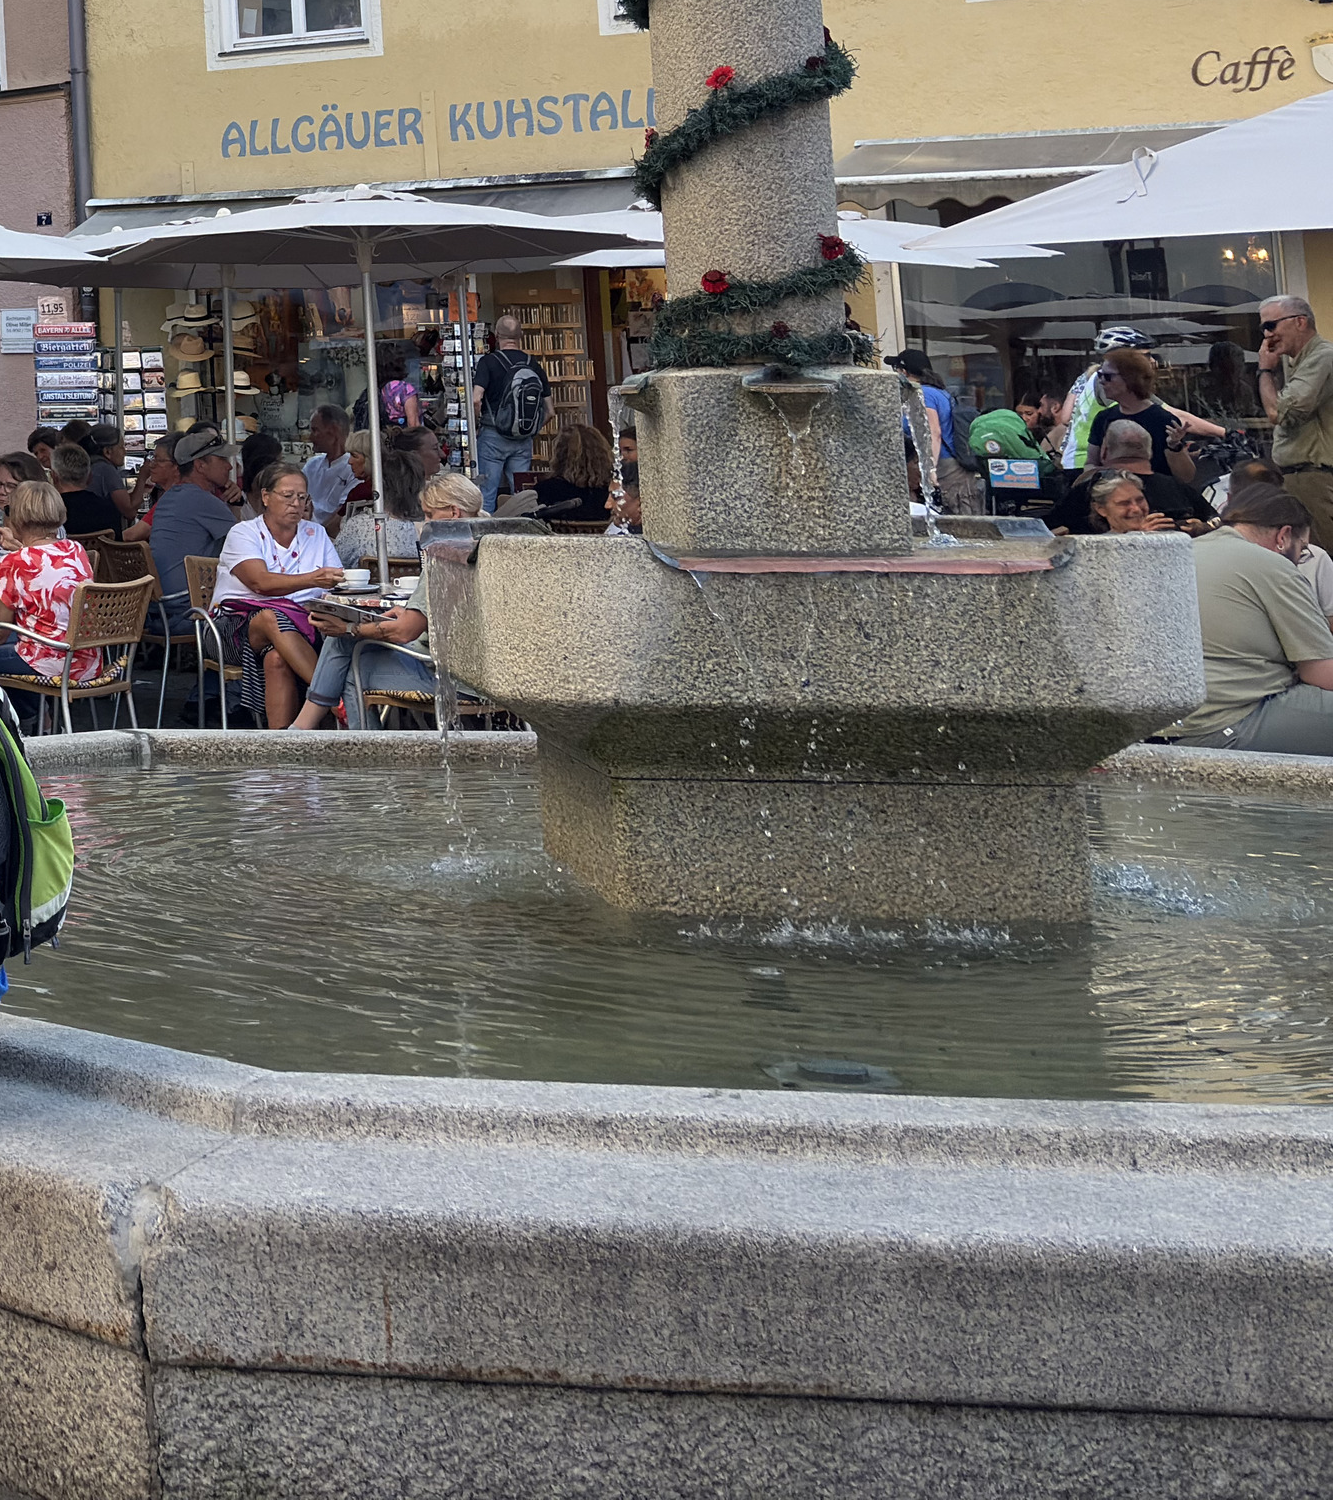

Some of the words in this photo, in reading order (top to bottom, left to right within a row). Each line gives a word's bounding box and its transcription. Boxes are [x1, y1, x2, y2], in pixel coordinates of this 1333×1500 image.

[1191, 45, 1296, 93] Caffè
[221, 103, 424, 159] ALLGÄUER
[40, 303, 64, 315] 11,95
